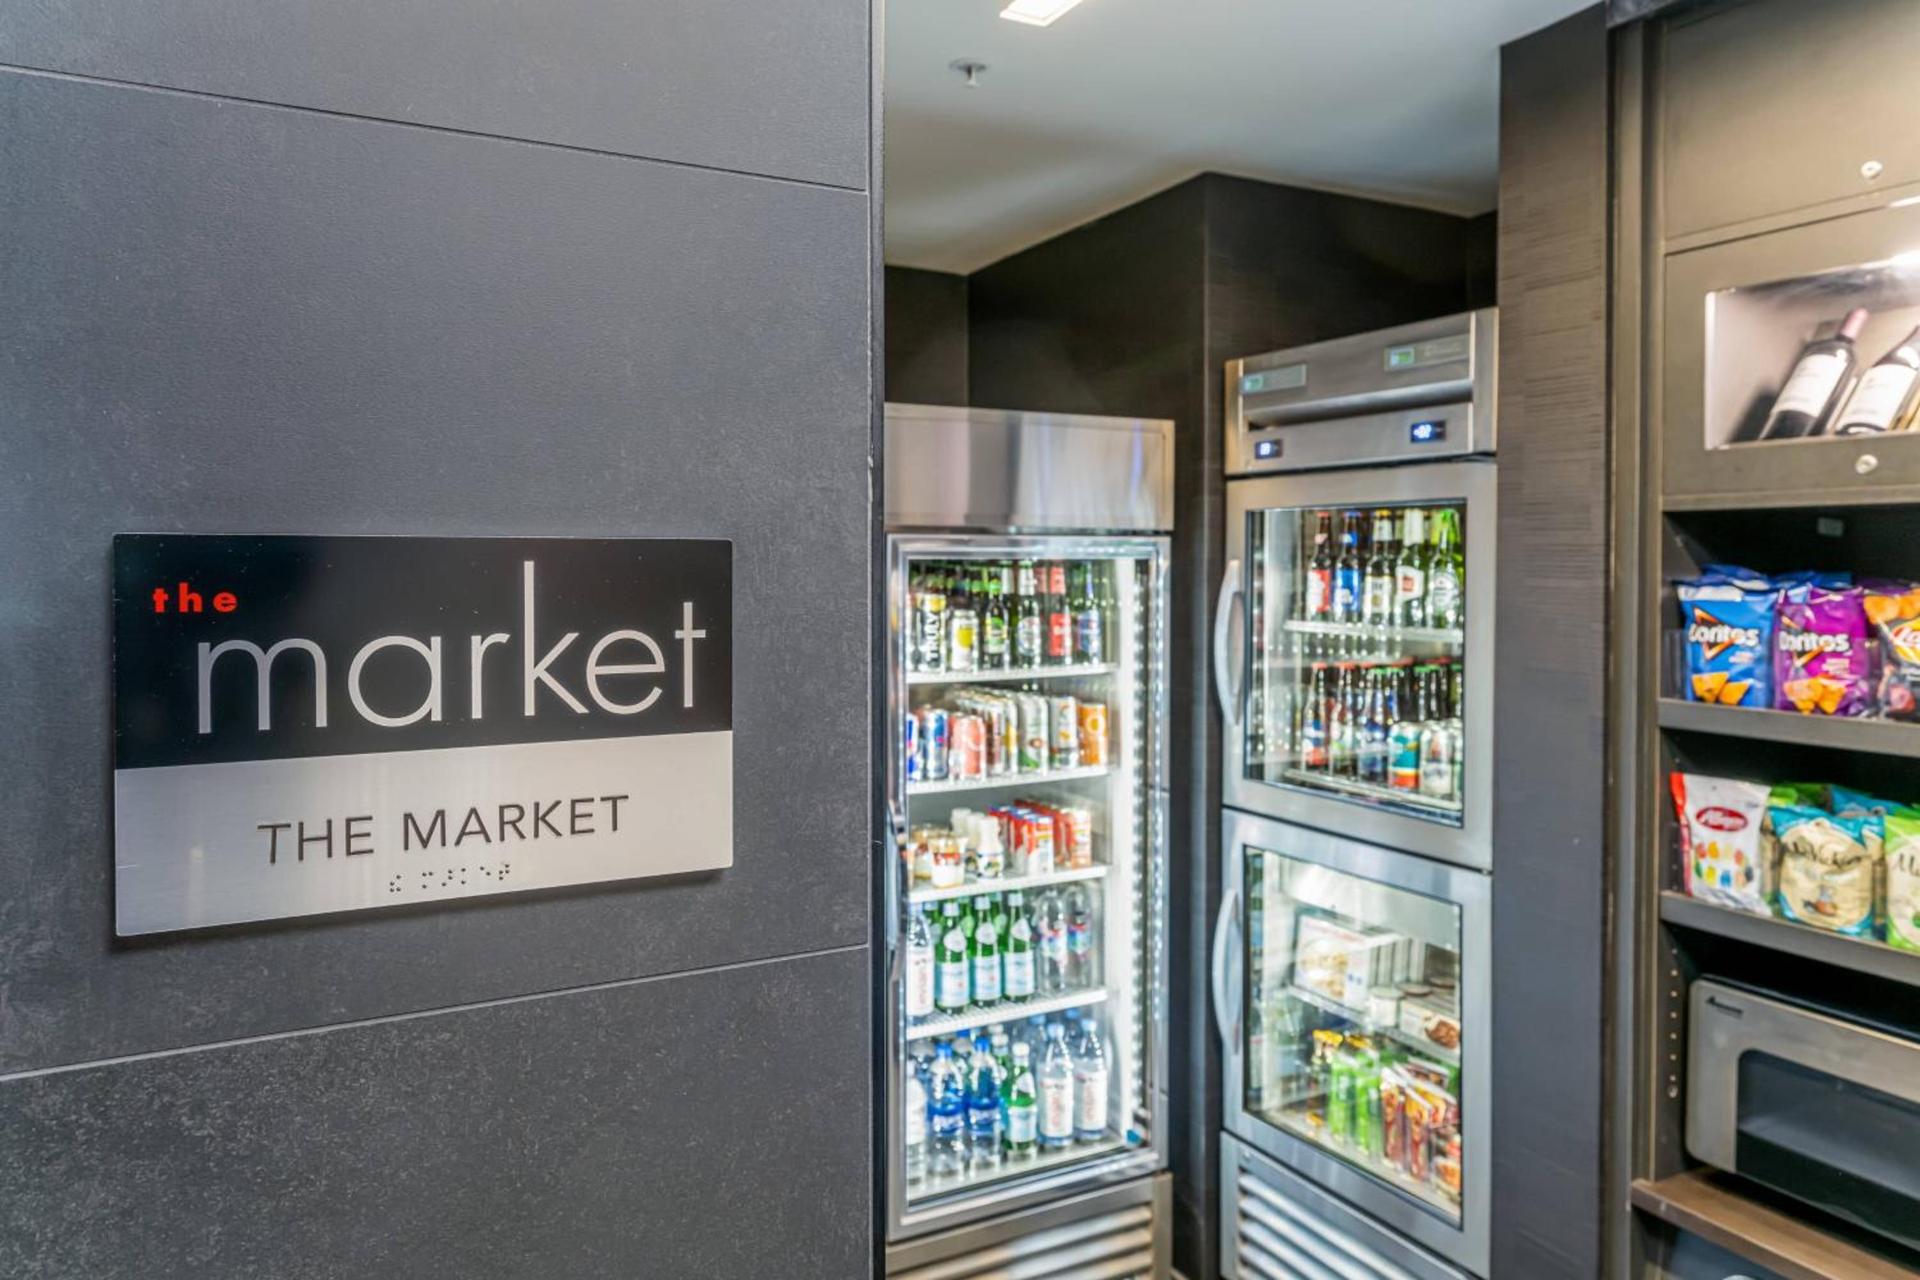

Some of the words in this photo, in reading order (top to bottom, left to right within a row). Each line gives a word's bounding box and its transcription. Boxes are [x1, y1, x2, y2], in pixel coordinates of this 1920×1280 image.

[152, 581, 238, 613] the
[198, 560, 706, 734] market
[256, 815, 374, 866] THE
[402, 795, 630, 851] MARKET
